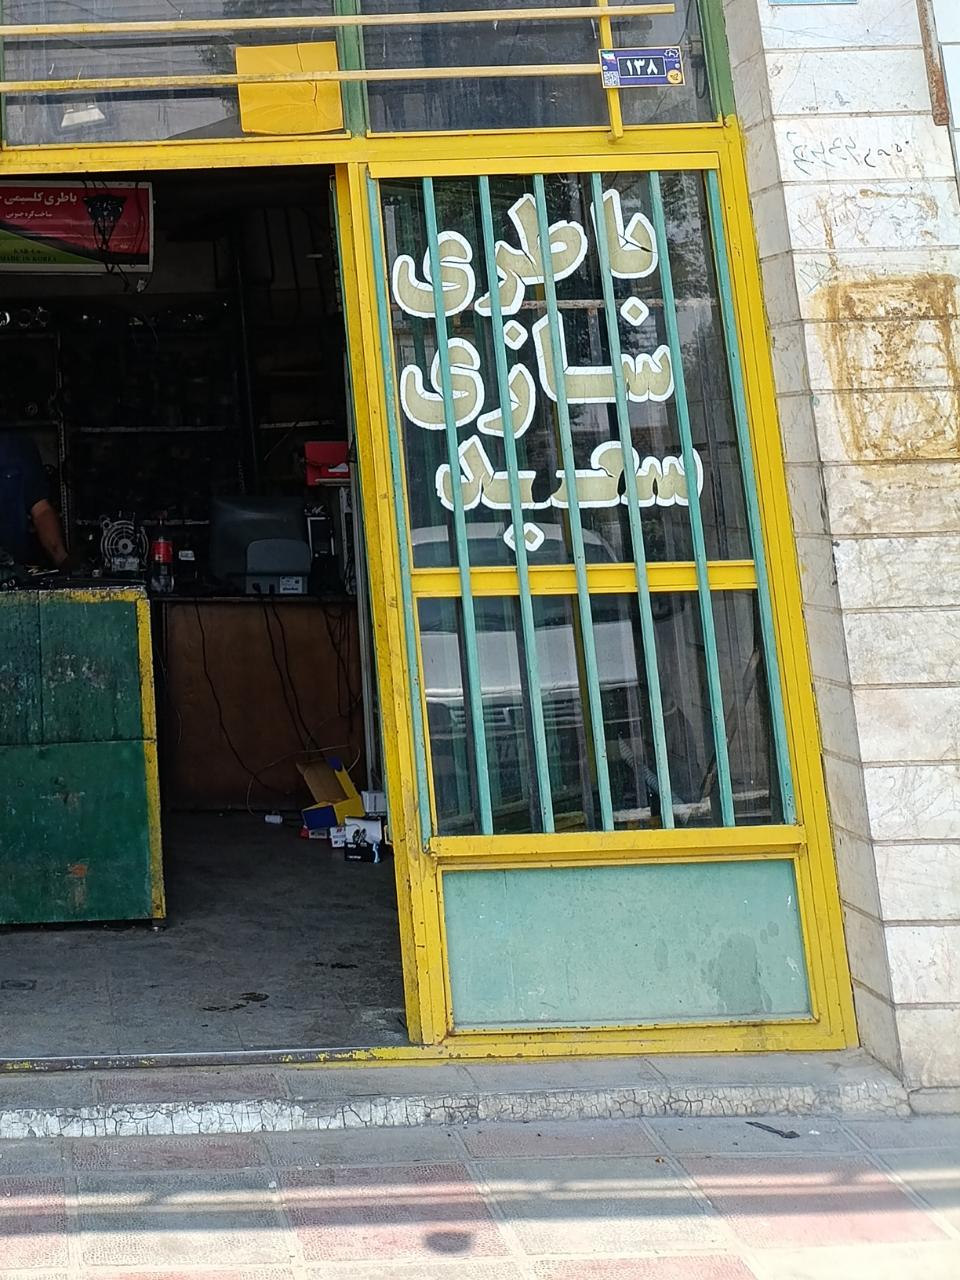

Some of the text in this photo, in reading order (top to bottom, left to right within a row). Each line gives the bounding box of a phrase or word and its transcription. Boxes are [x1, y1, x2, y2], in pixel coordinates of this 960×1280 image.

[626, 58, 658, 75] ۱۳۸
[44, 191, 77, 206] باطری
[393, 188, 659, 326] باطری
[400, 310, 675, 440] سازی
[435, 434, 704, 552] سعید
